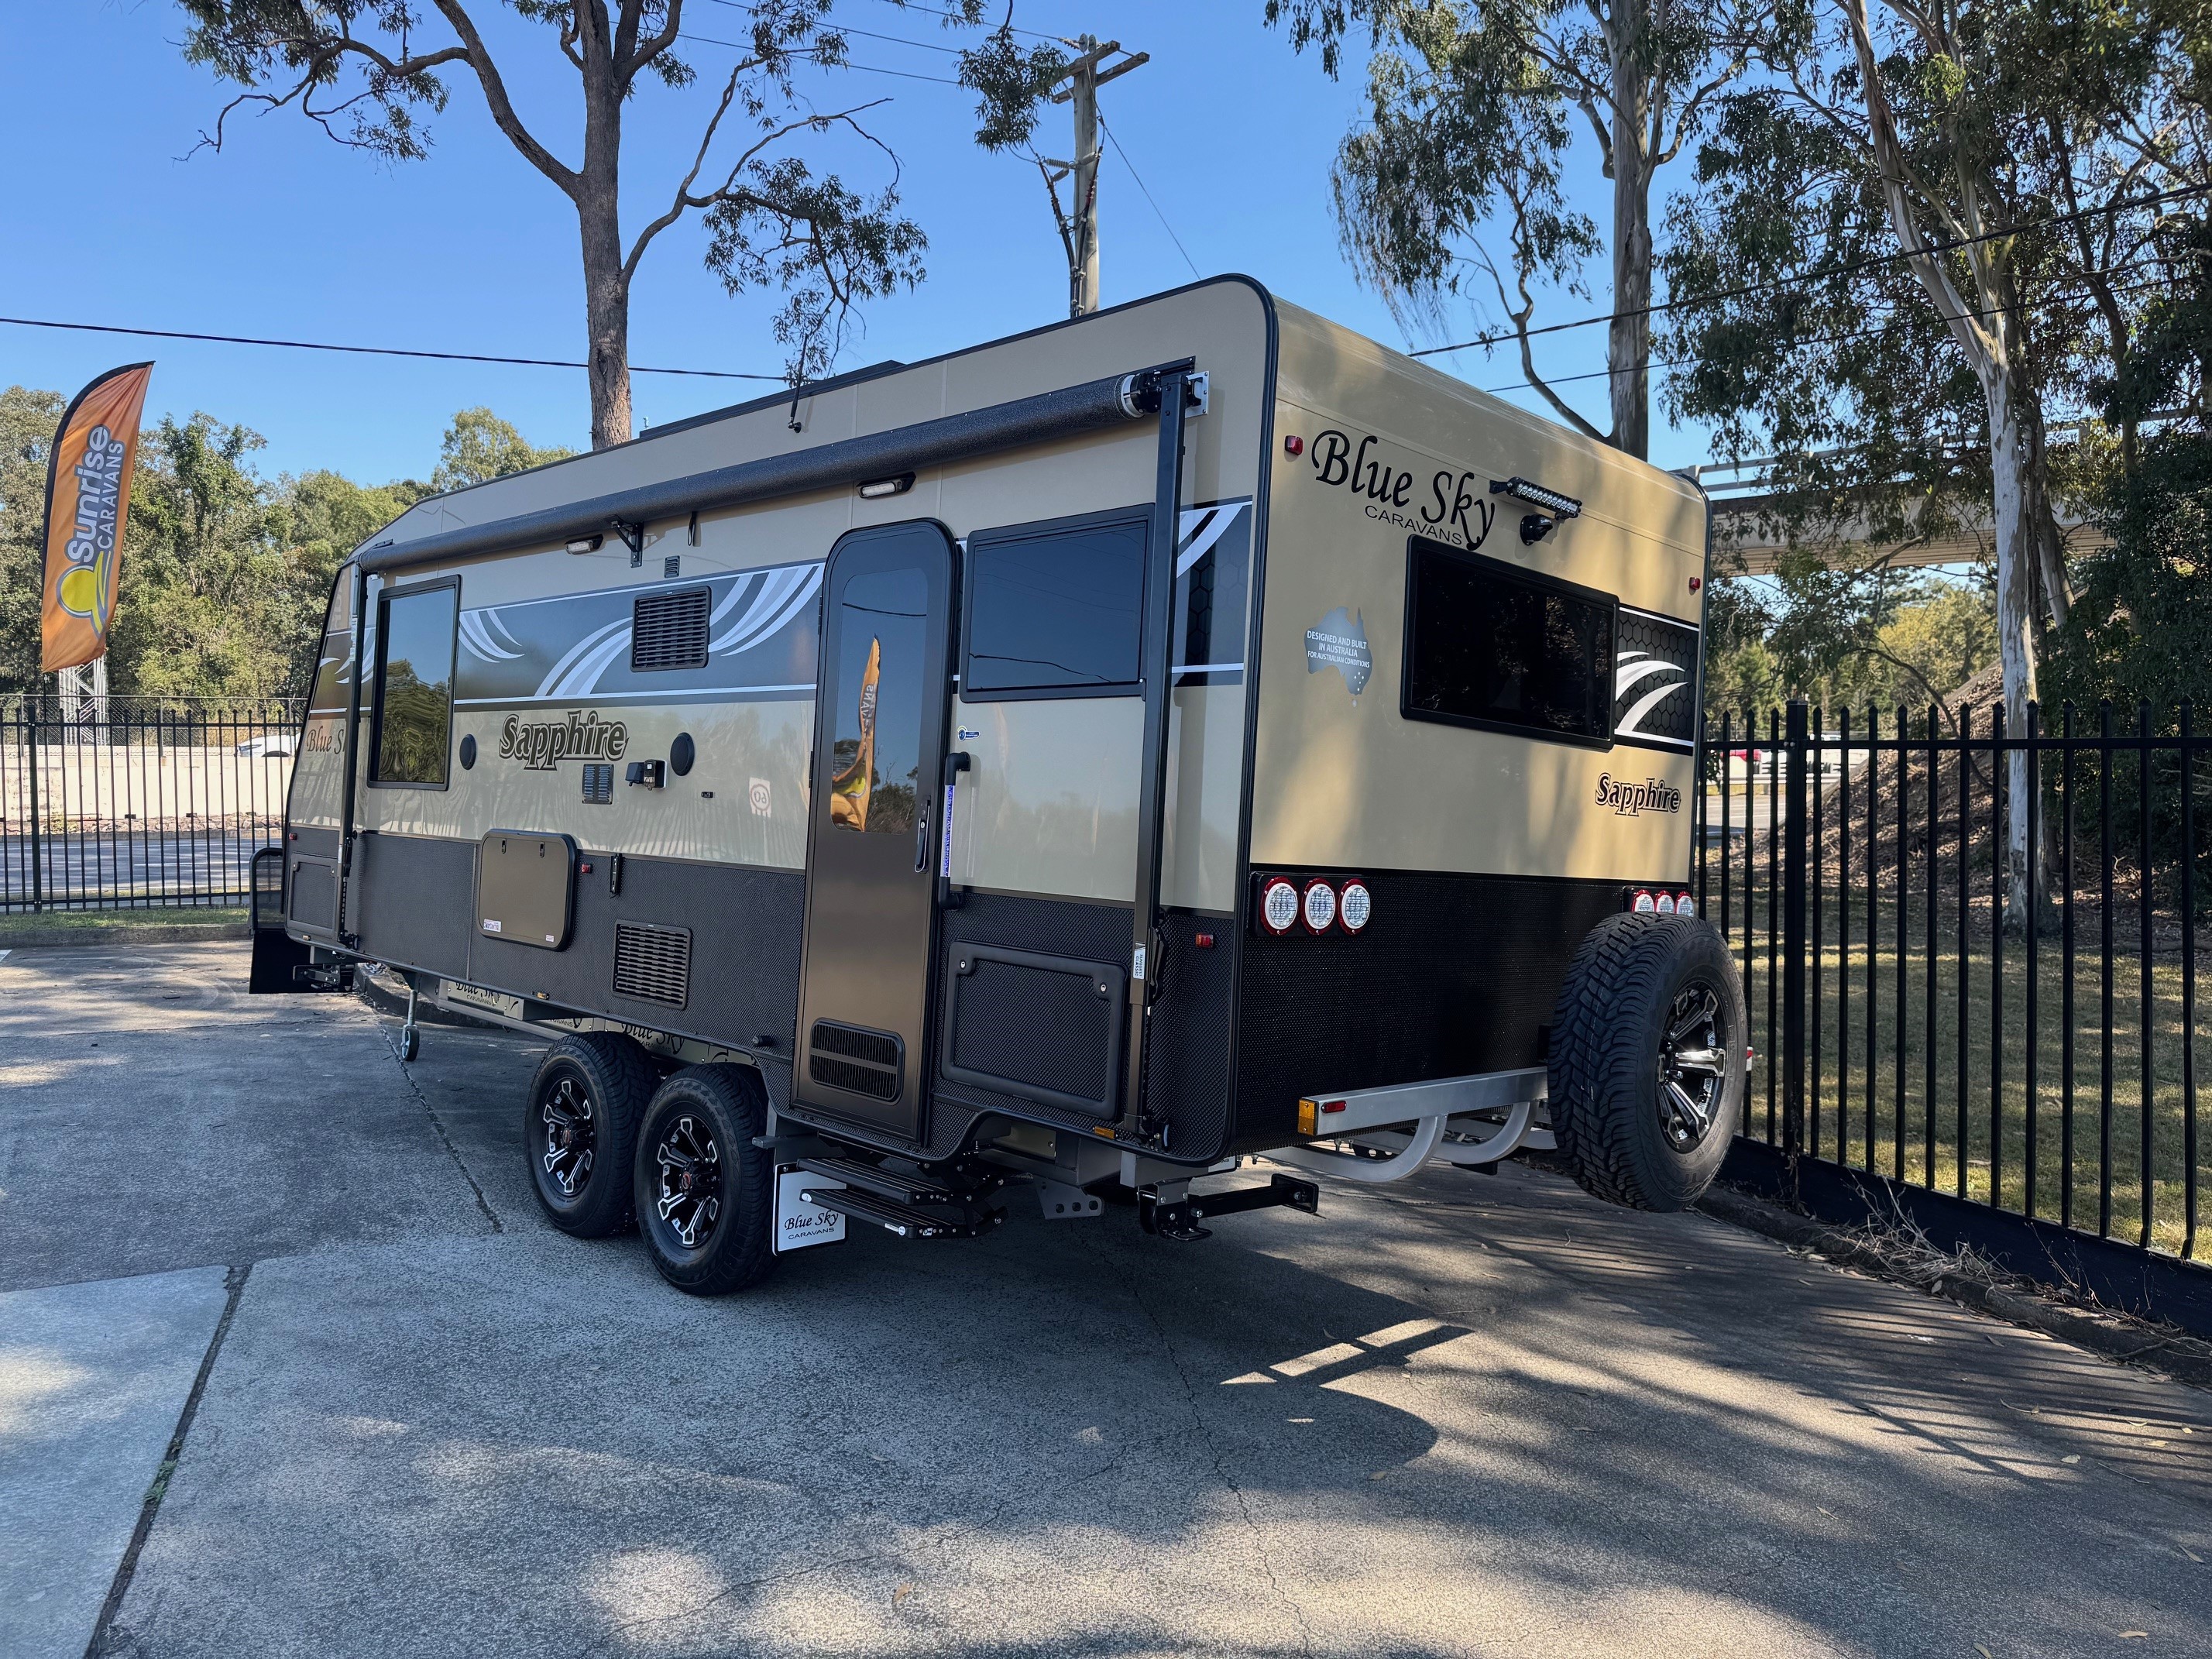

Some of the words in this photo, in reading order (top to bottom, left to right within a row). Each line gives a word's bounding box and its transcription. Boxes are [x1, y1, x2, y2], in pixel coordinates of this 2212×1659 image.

[67, 426, 108, 563] Sunrise
[97, 442, 123, 549] CARAVANS
[1311, 429, 1413, 508] Blue
[1420, 470, 1496, 551] Sky
[1365, 505, 1462, 545] CARAVANS
[1307, 630, 1338, 644] DESIGNED
[1338, 637, 1351, 647] AND
[1351, 639, 1367, 650] BUILT
[1318, 642, 1325, 651] IN
[1326, 644, 1358, 658] AUSTRALIA
[1317, 652, 1345, 664] AUSTRALIAN
[1345, 658, 1370, 668] CONDITIONS
[306, 725, 332, 752] Blue
[499, 709, 630, 771] Sapphire
[1595, 772, 1681, 817] Sapphire
[638, 1039, 672, 1053] ARAVANS
[784, 1214, 812, 1231] Blue
[814, 1210, 839, 1227] Sky
[788, 1227, 835, 1240] CARAVANS
